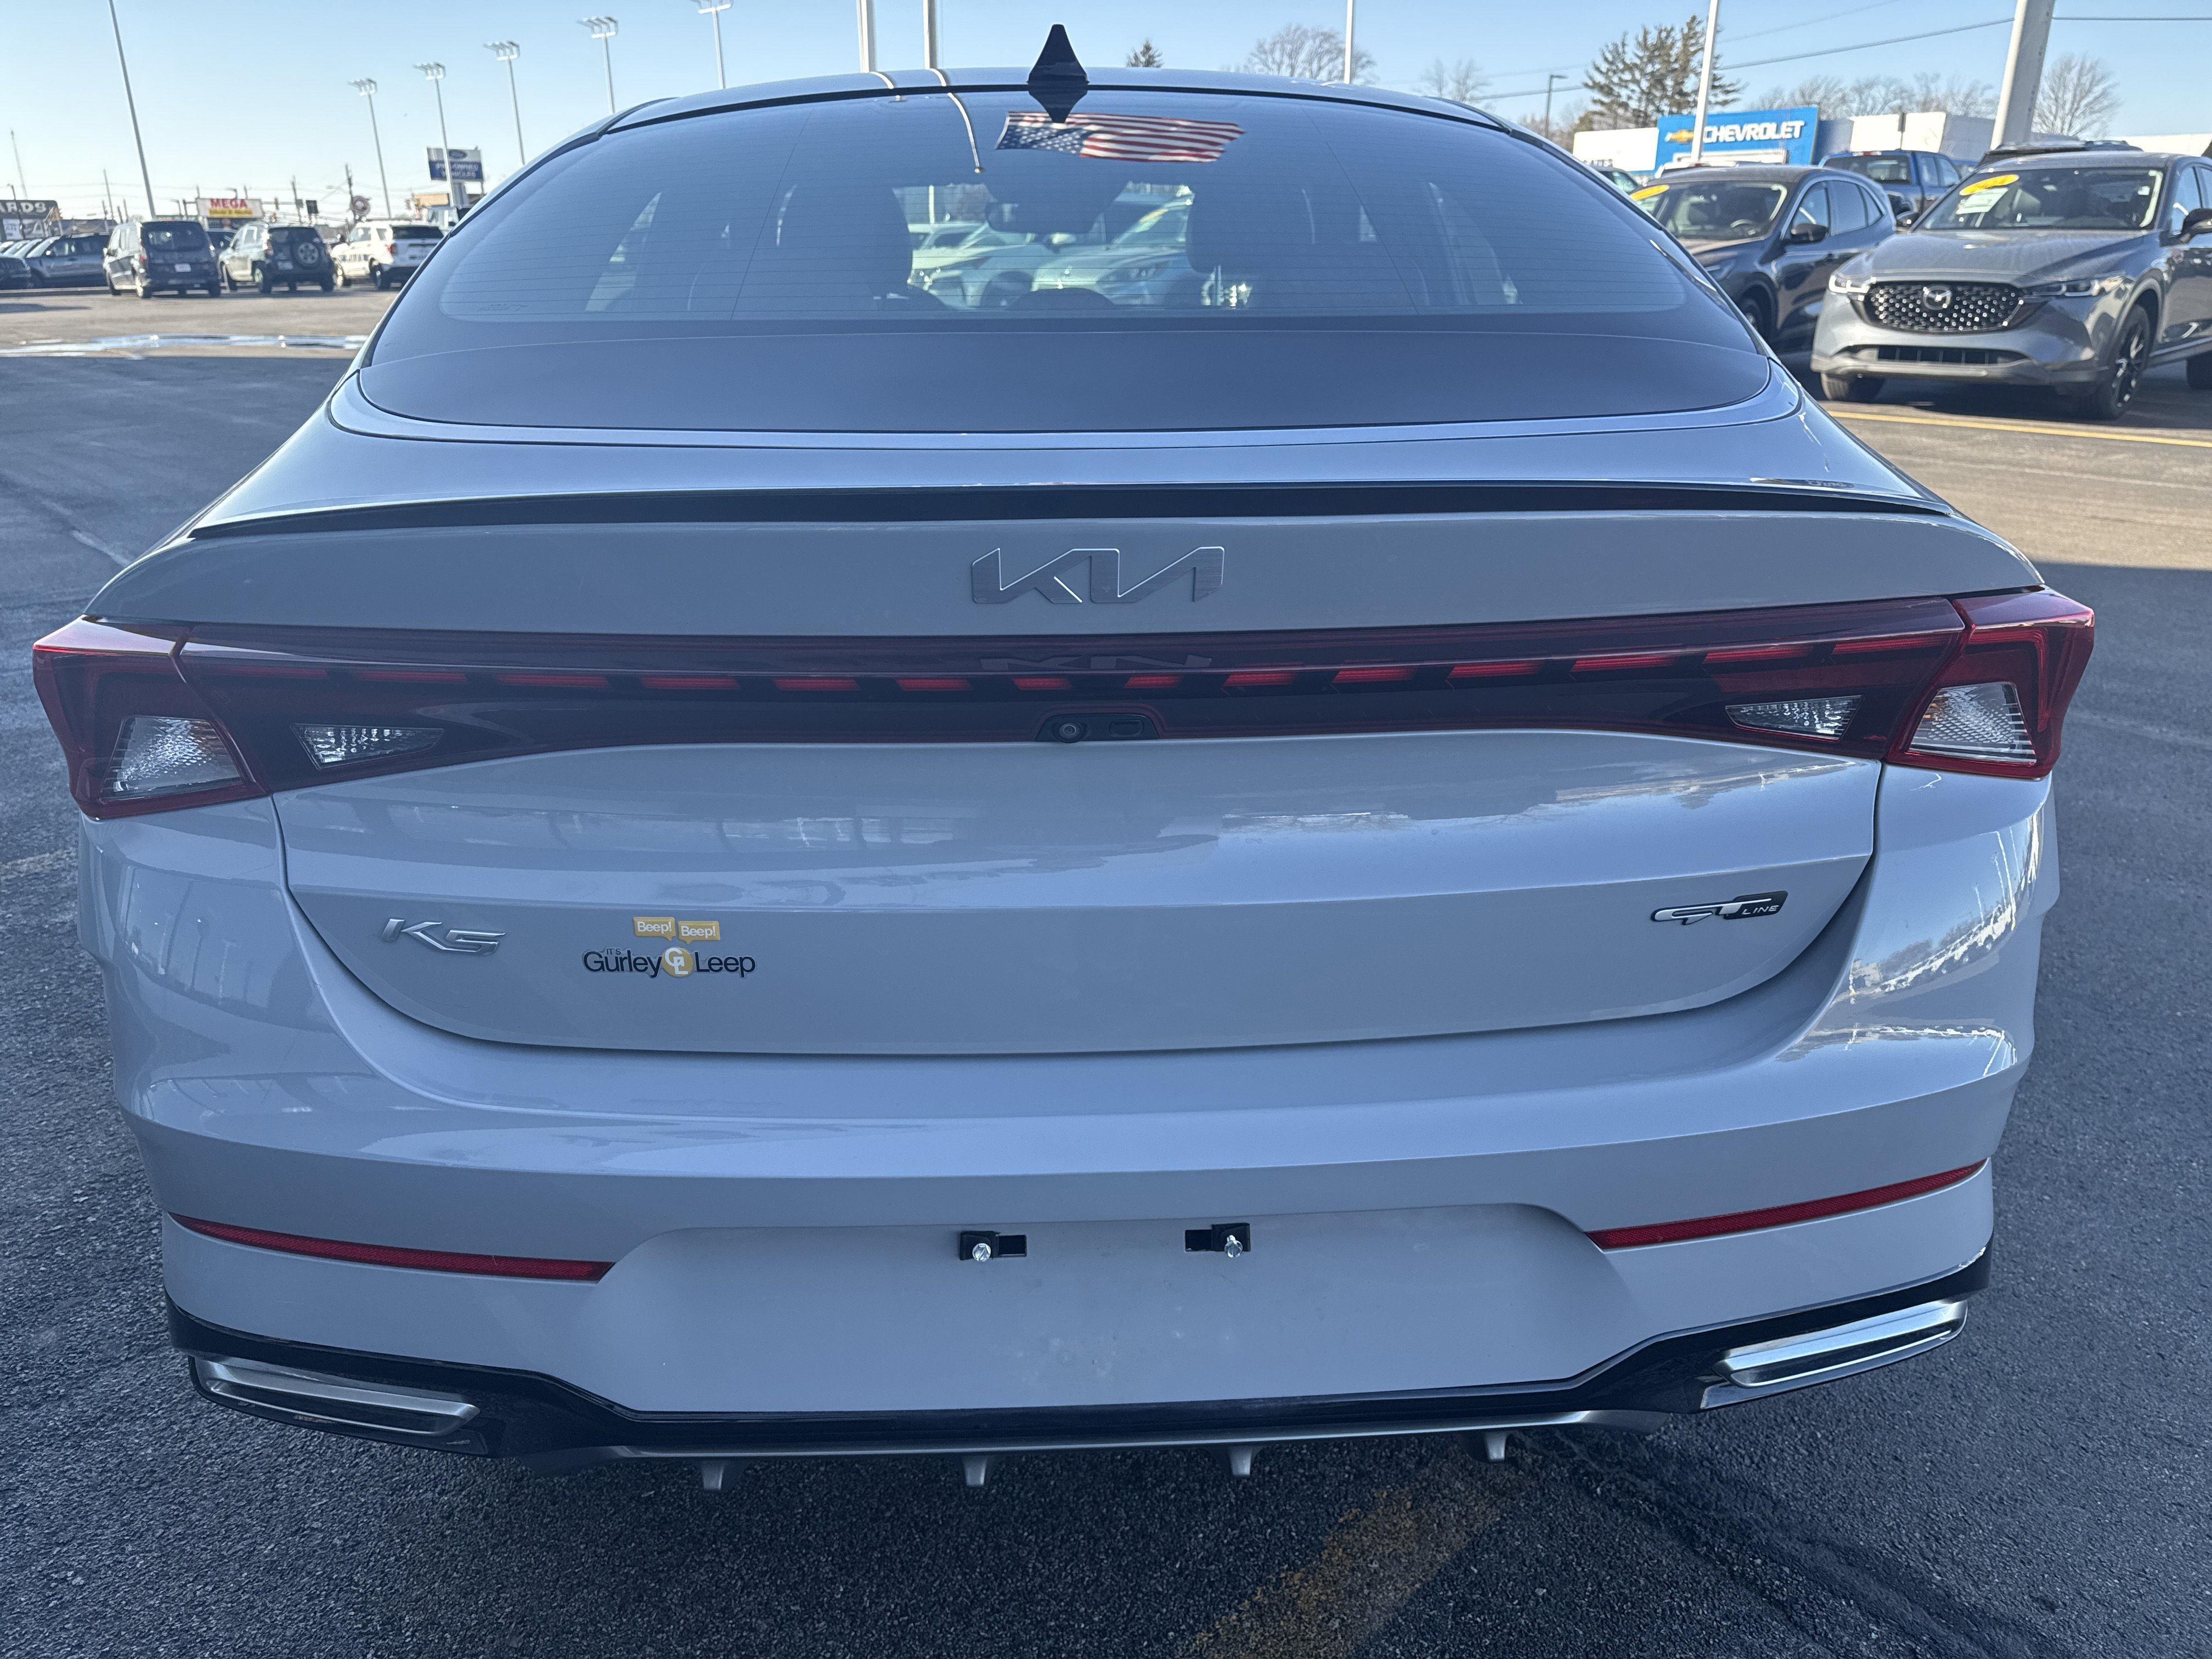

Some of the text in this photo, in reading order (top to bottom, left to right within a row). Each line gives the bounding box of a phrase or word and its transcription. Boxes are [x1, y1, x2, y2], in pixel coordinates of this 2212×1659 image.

[1703, 121, 1805, 143] CHEVROLET
[435, 163, 478, 171] PR-OWNED
[210, 199, 248, 208] MEGA
[972, 546, 1225, 603] KIA
[1741, 905, 1780, 916] LINE
[382, 918, 505, 955] K5
[637, 921, 716, 938] Beep! Beep!
[583, 950, 662, 978] Gurley
[695, 952, 755, 978] Leep
